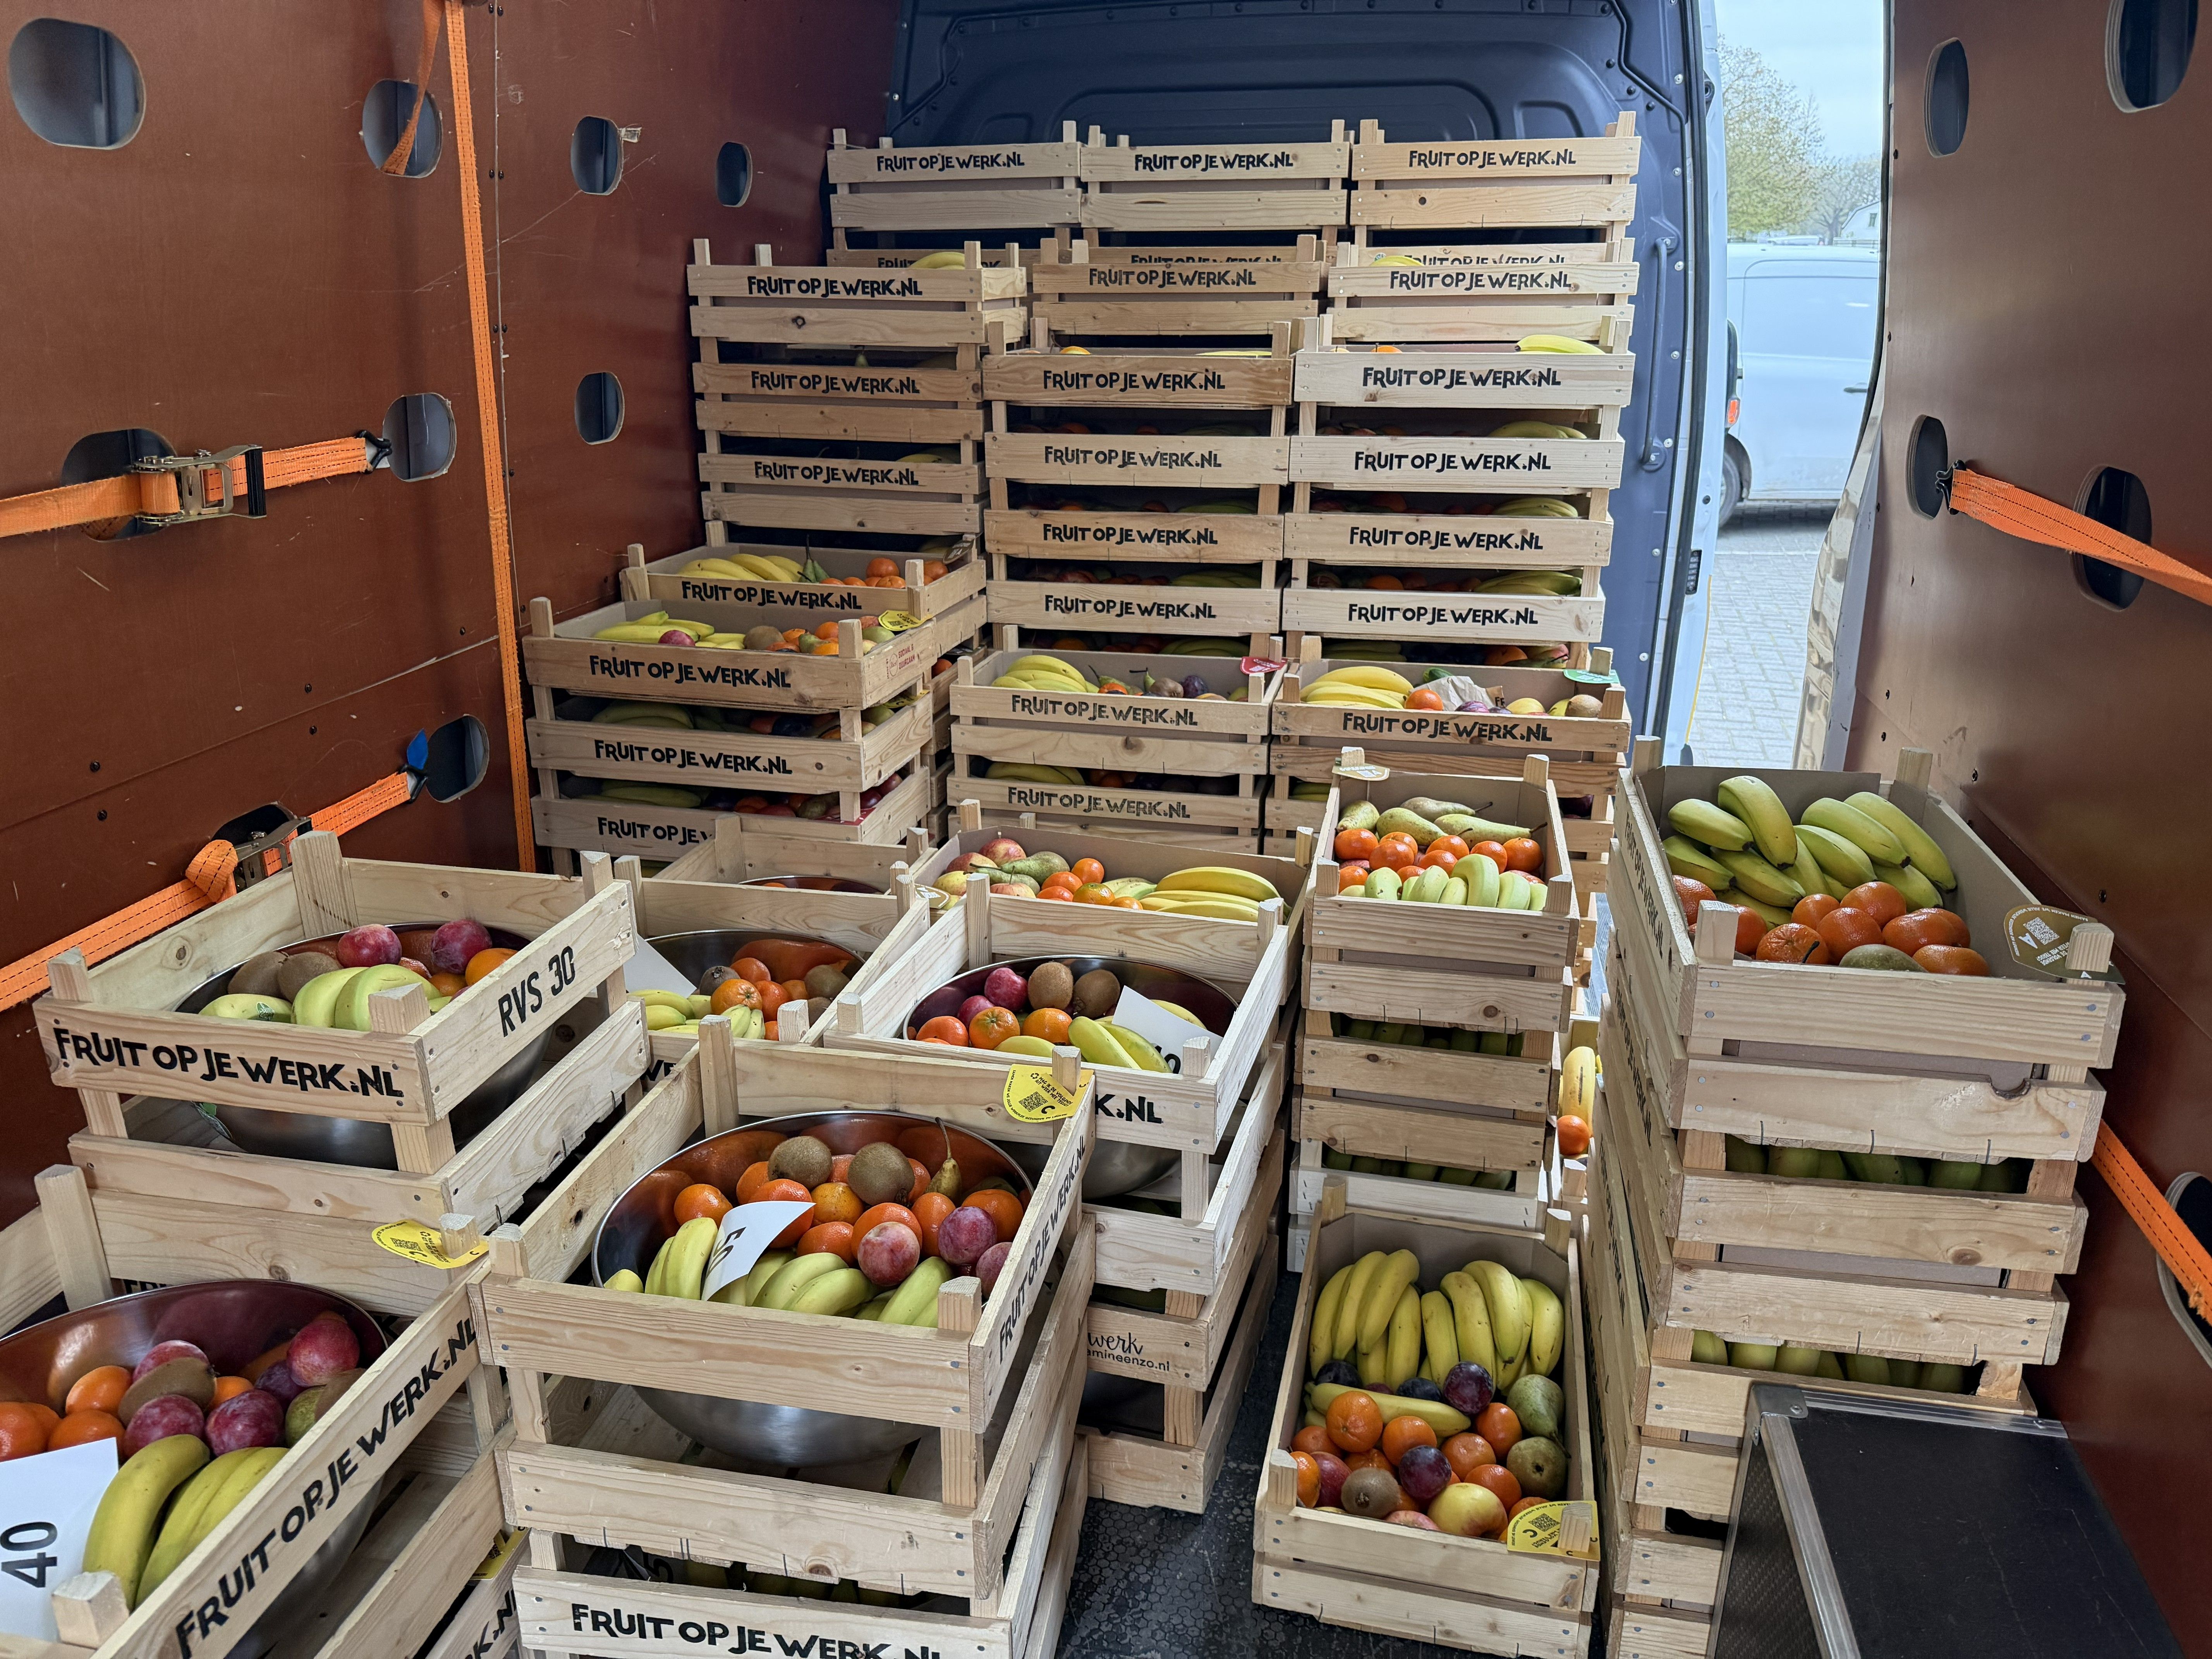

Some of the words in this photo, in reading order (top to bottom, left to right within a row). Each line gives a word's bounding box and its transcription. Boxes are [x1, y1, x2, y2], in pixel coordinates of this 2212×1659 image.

[877, 152, 1025, 172] FRUITOPJEWERK.NL
[1135, 152, 1293, 172] FRUITOPJEWERK.NL
[1409, 149, 1576, 168] FRUITOPJEWERK.NL
[747, 276, 922, 298] FRUITOPJEWERK.NL
[1090, 268, 1256, 288] FRUITOPJEWERK.NL
[1390, 271, 1571, 290] FRUITOPJEWERK.NL
[751, 371, 920, 395] FRUITOPJEWERK.NL
[1044, 371, 1225, 392] FRUITOPJEWERK.NL
[1363, 368, 1561, 389] FRUITOPJEWERK.NL
[1045, 446, 1221, 469] FRUITOPJEWERK.NL
[1355, 452, 1551, 472] FRUITOPJEWERK.NL
[754, 461, 919, 486] FRUITOPJEWERK.NL
[1044, 524, 1218, 545] FRUITOPJEWERK.NL
[1350, 527, 1543, 551] FRUITOPJEWERK.NL
[682, 581, 862, 610] FRUITOPJEWERK.NL
[1045, 595, 1216, 619] FRUITOPJEWERK.NL
[1348, 604, 1538, 625] FRUITOPJEWERK.NL
[590, 656, 791, 688] FRUITOPJEWERK.NL
[1012, 695, 1198, 726] FRUITOPJEWERK.NL
[1343, 713, 1552, 742] FRUITOPJEWERK.NL
[594, 740, 792, 774] FRUITOPJEWERK.NL
[1008, 787, 1190, 818] FRUITOPJEWERK.NL
[2018, 933, 2038, 949] A
[498, 972, 542, 1037] RVS
[548, 946, 575, 996] 30
[53, 1027, 403, 1097] FRUITOPJEWERK.NL
[1041, 1085, 1051, 1094] WEER
[1041, 1106, 1055, 1114] C
[999, 1134, 1085, 1364] FRUITOPJEWERK.NL
[1088, 1332, 1143, 1355] werk
[0, 1521, 58, 1588] 40
[571, 1604, 940, 1659] FRUITOPJEWERK
